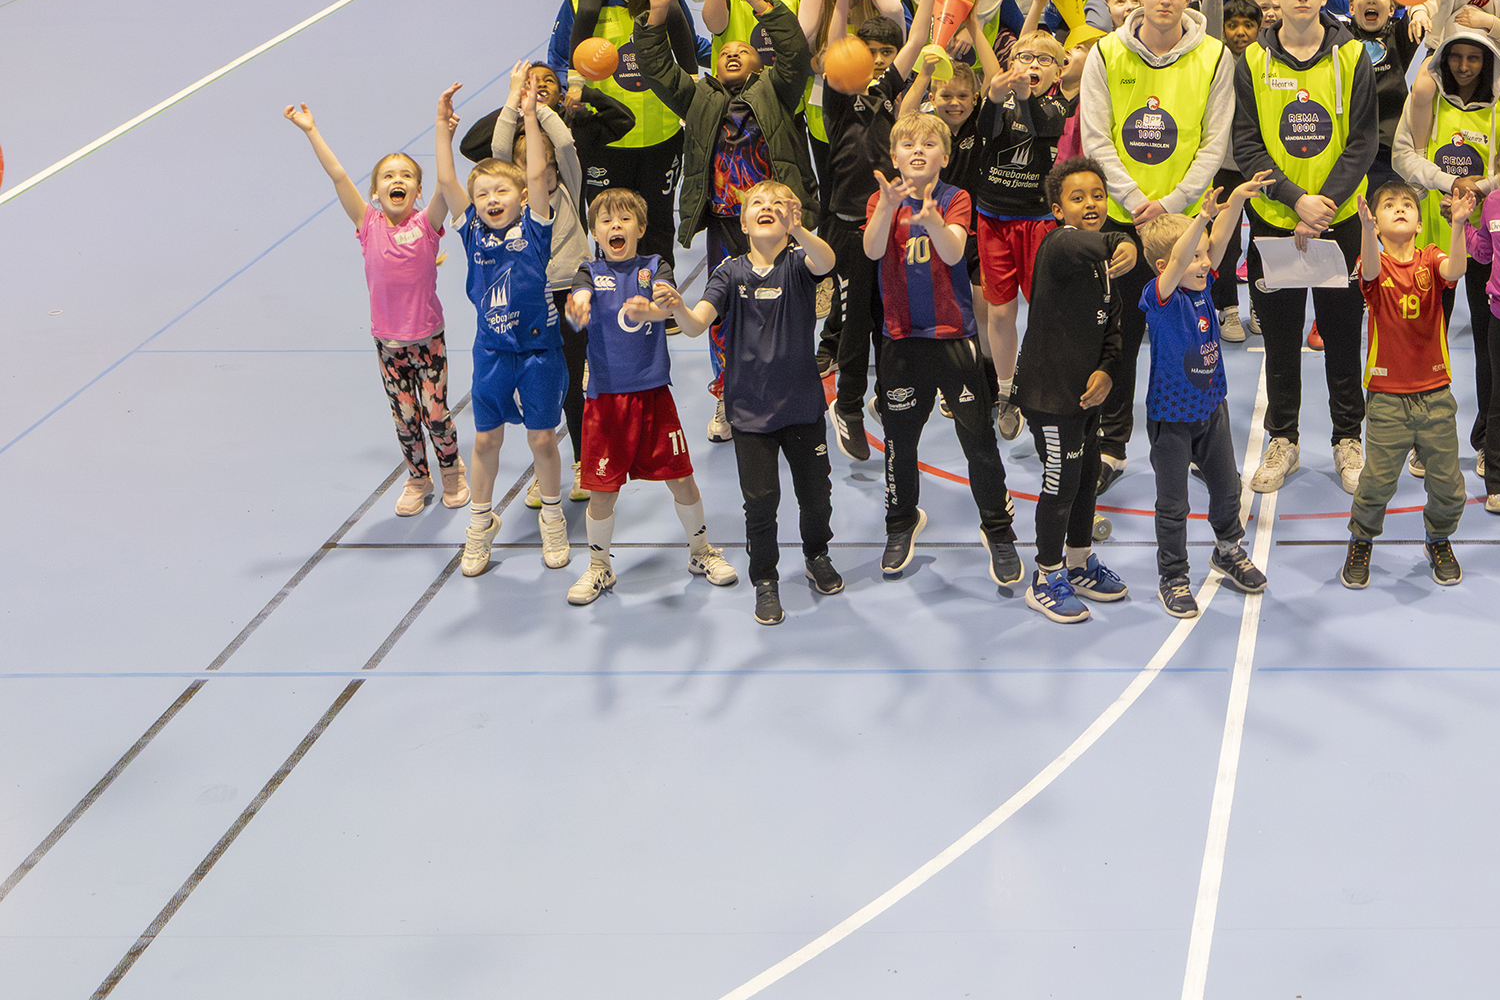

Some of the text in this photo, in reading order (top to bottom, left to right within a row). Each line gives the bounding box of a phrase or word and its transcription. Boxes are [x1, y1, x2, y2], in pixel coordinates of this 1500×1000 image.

[1288, 113, 1320, 123] REMA
[1292, 123, 1316, 133] 1000
[1138, 129, 1161, 139] 1000
[1443, 156, 1472, 166] REMA
[989, 166, 1040, 181] sparebanken
[1446, 166, 1469, 175] 1000
[906, 236, 931, 265] 10
[1398, 293, 1420, 320] 19
[668, 429, 686, 455] 11
